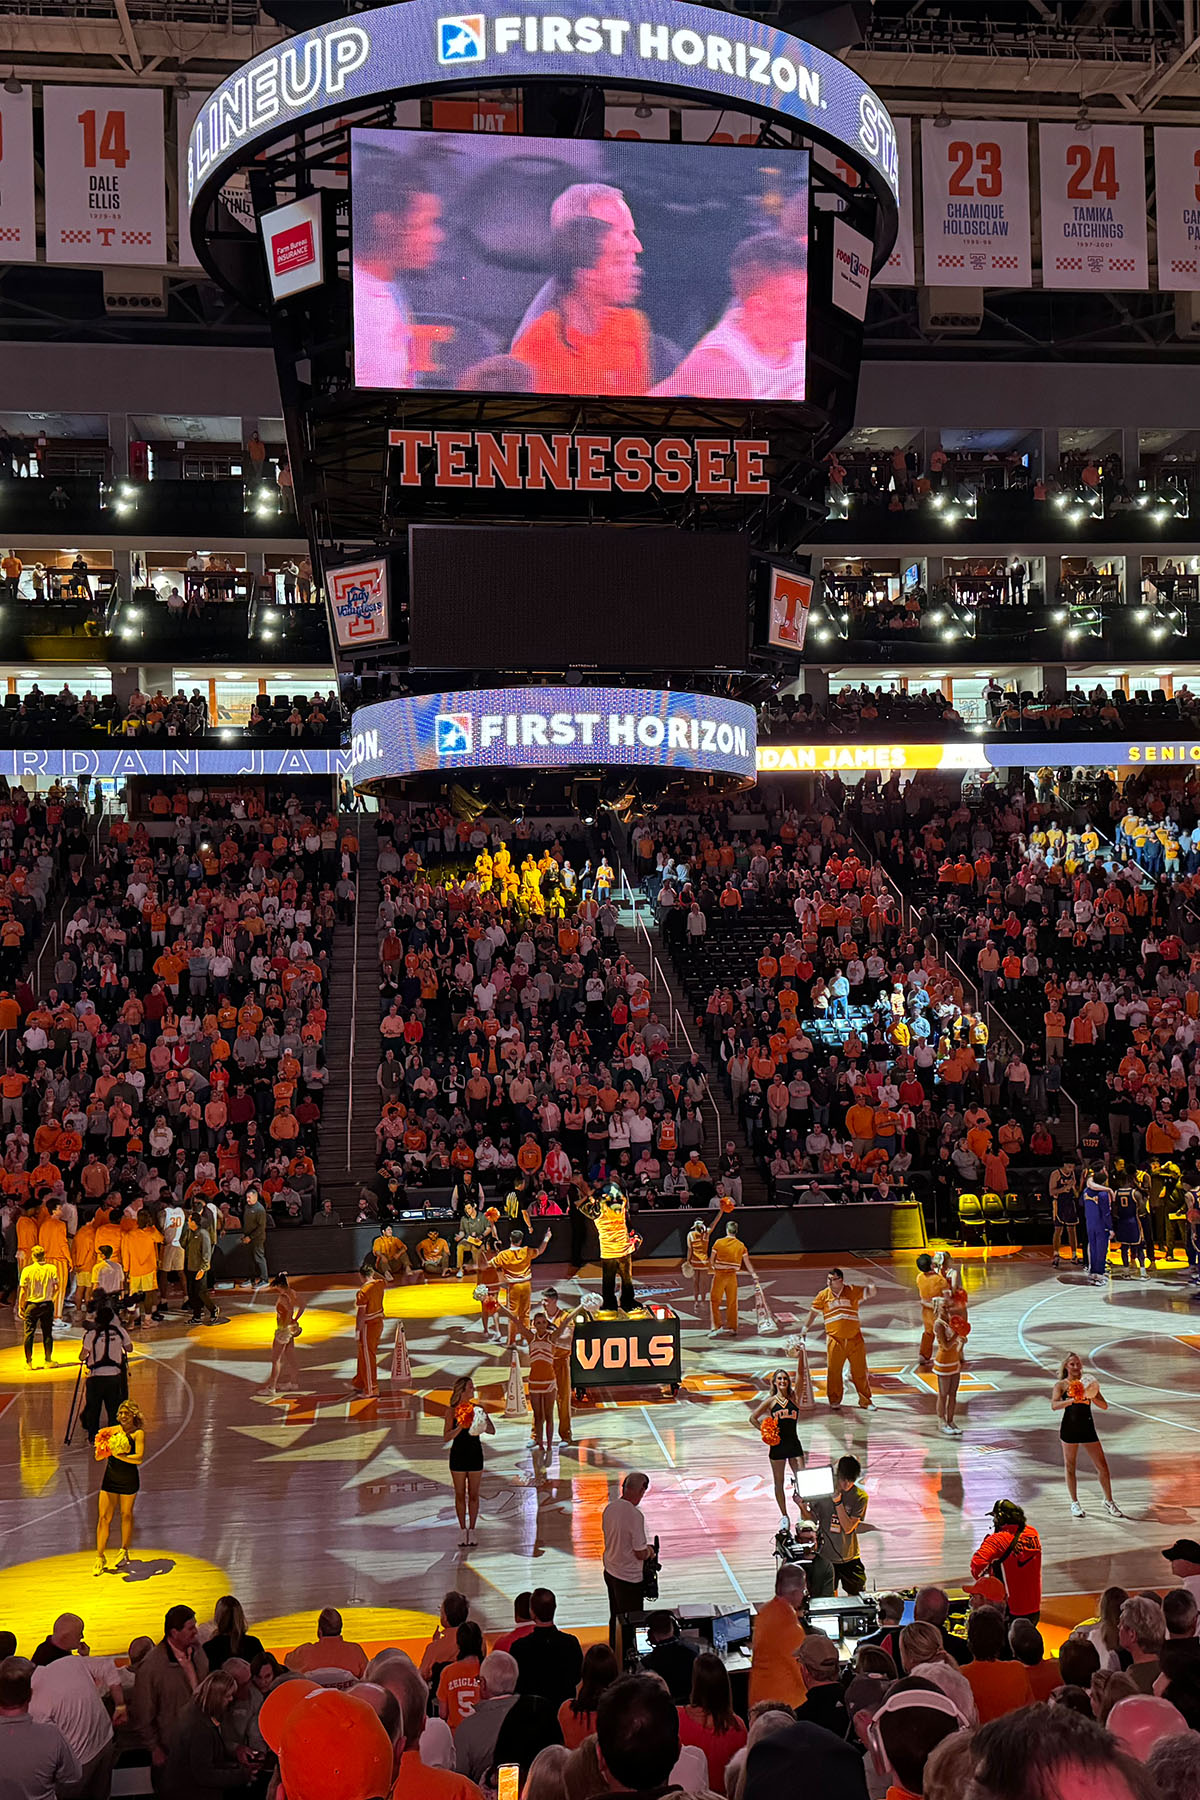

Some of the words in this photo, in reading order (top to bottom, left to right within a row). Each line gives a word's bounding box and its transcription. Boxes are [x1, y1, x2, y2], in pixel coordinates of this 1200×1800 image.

[495, 16, 630, 55] FIRST
[640, 23, 827, 110] HORIZON.
[197, 27, 370, 180] LINEUP
[78, 110, 130, 168] 14
[948, 141, 1002, 197] 23
[1066, 145, 1119, 200] 24
[89, 176, 119, 192] DALE
[89, 193, 120, 209] ELLIS
[947, 203, 1004, 220] CHAMIQUE
[1073, 206, 1113, 222] TAMIKA
[943, 220, 1008, 236] HOLDSCLAW
[1063, 223, 1124, 239] CATCHINGS
[276, 245, 290, 256] Farm
[290, 238, 308, 250] Bureau
[277, 244, 309, 263] INSURANCE
[836, 247, 851, 266] FOOD
[388, 429, 770, 495] TENNESSEE
[774, 575, 811, 643] T
[480, 713, 600, 747] FIRST
[13, 749, 199, 775] RDAN
[823, 747, 905, 768] JAMES
[1120, 1196, 1129, 1208] 0
[170, 1216, 182, 1228] 30
[575, 1335, 674, 1370] VOLS
[365, 1480, 440, 1496] THE
[457, 1690, 477, 1718] 5
